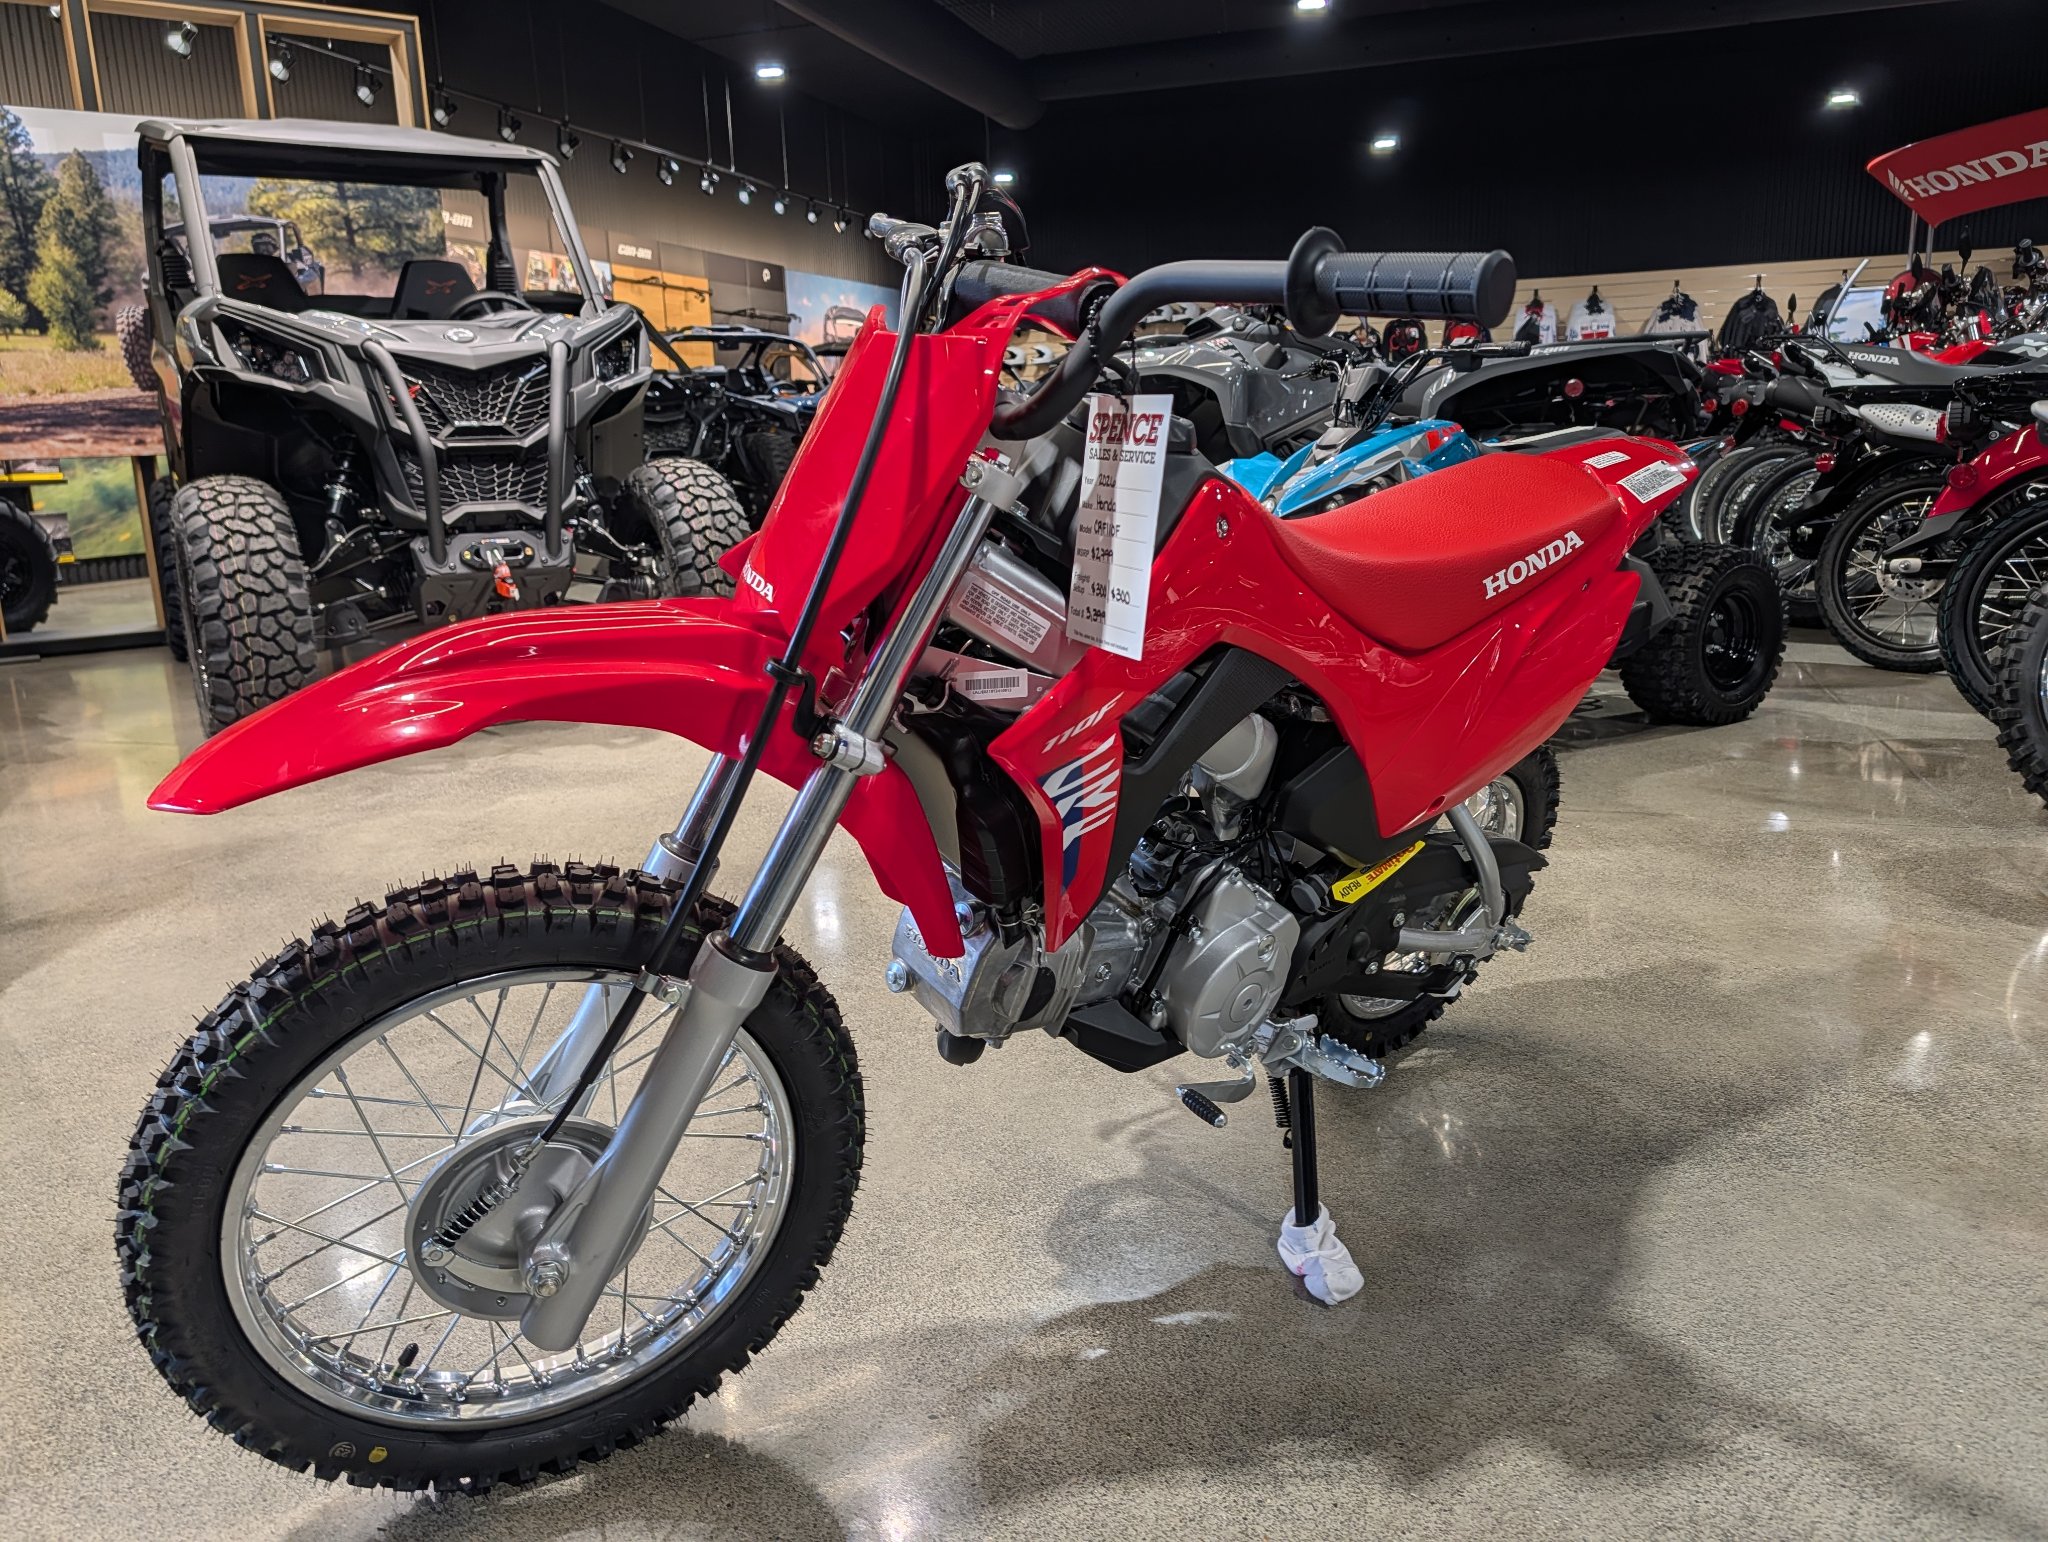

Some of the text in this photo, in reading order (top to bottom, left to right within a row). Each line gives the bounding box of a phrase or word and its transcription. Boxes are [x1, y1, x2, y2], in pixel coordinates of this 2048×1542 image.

[617, 244, 652, 260] can-am
[1848, 351, 1899, 365] HONDA
[1089, 412, 1164, 447] SPENCE
[1089, 448, 1156, 464] SALES & SERVICE
[1080, 524, 1092, 534] Model
[1482, 530, 1584, 600] HONDA
[1111, 587, 1130, 605] $300
[1041, 691, 1124, 754] 110F
[1339, 880, 1362, 899] READY
